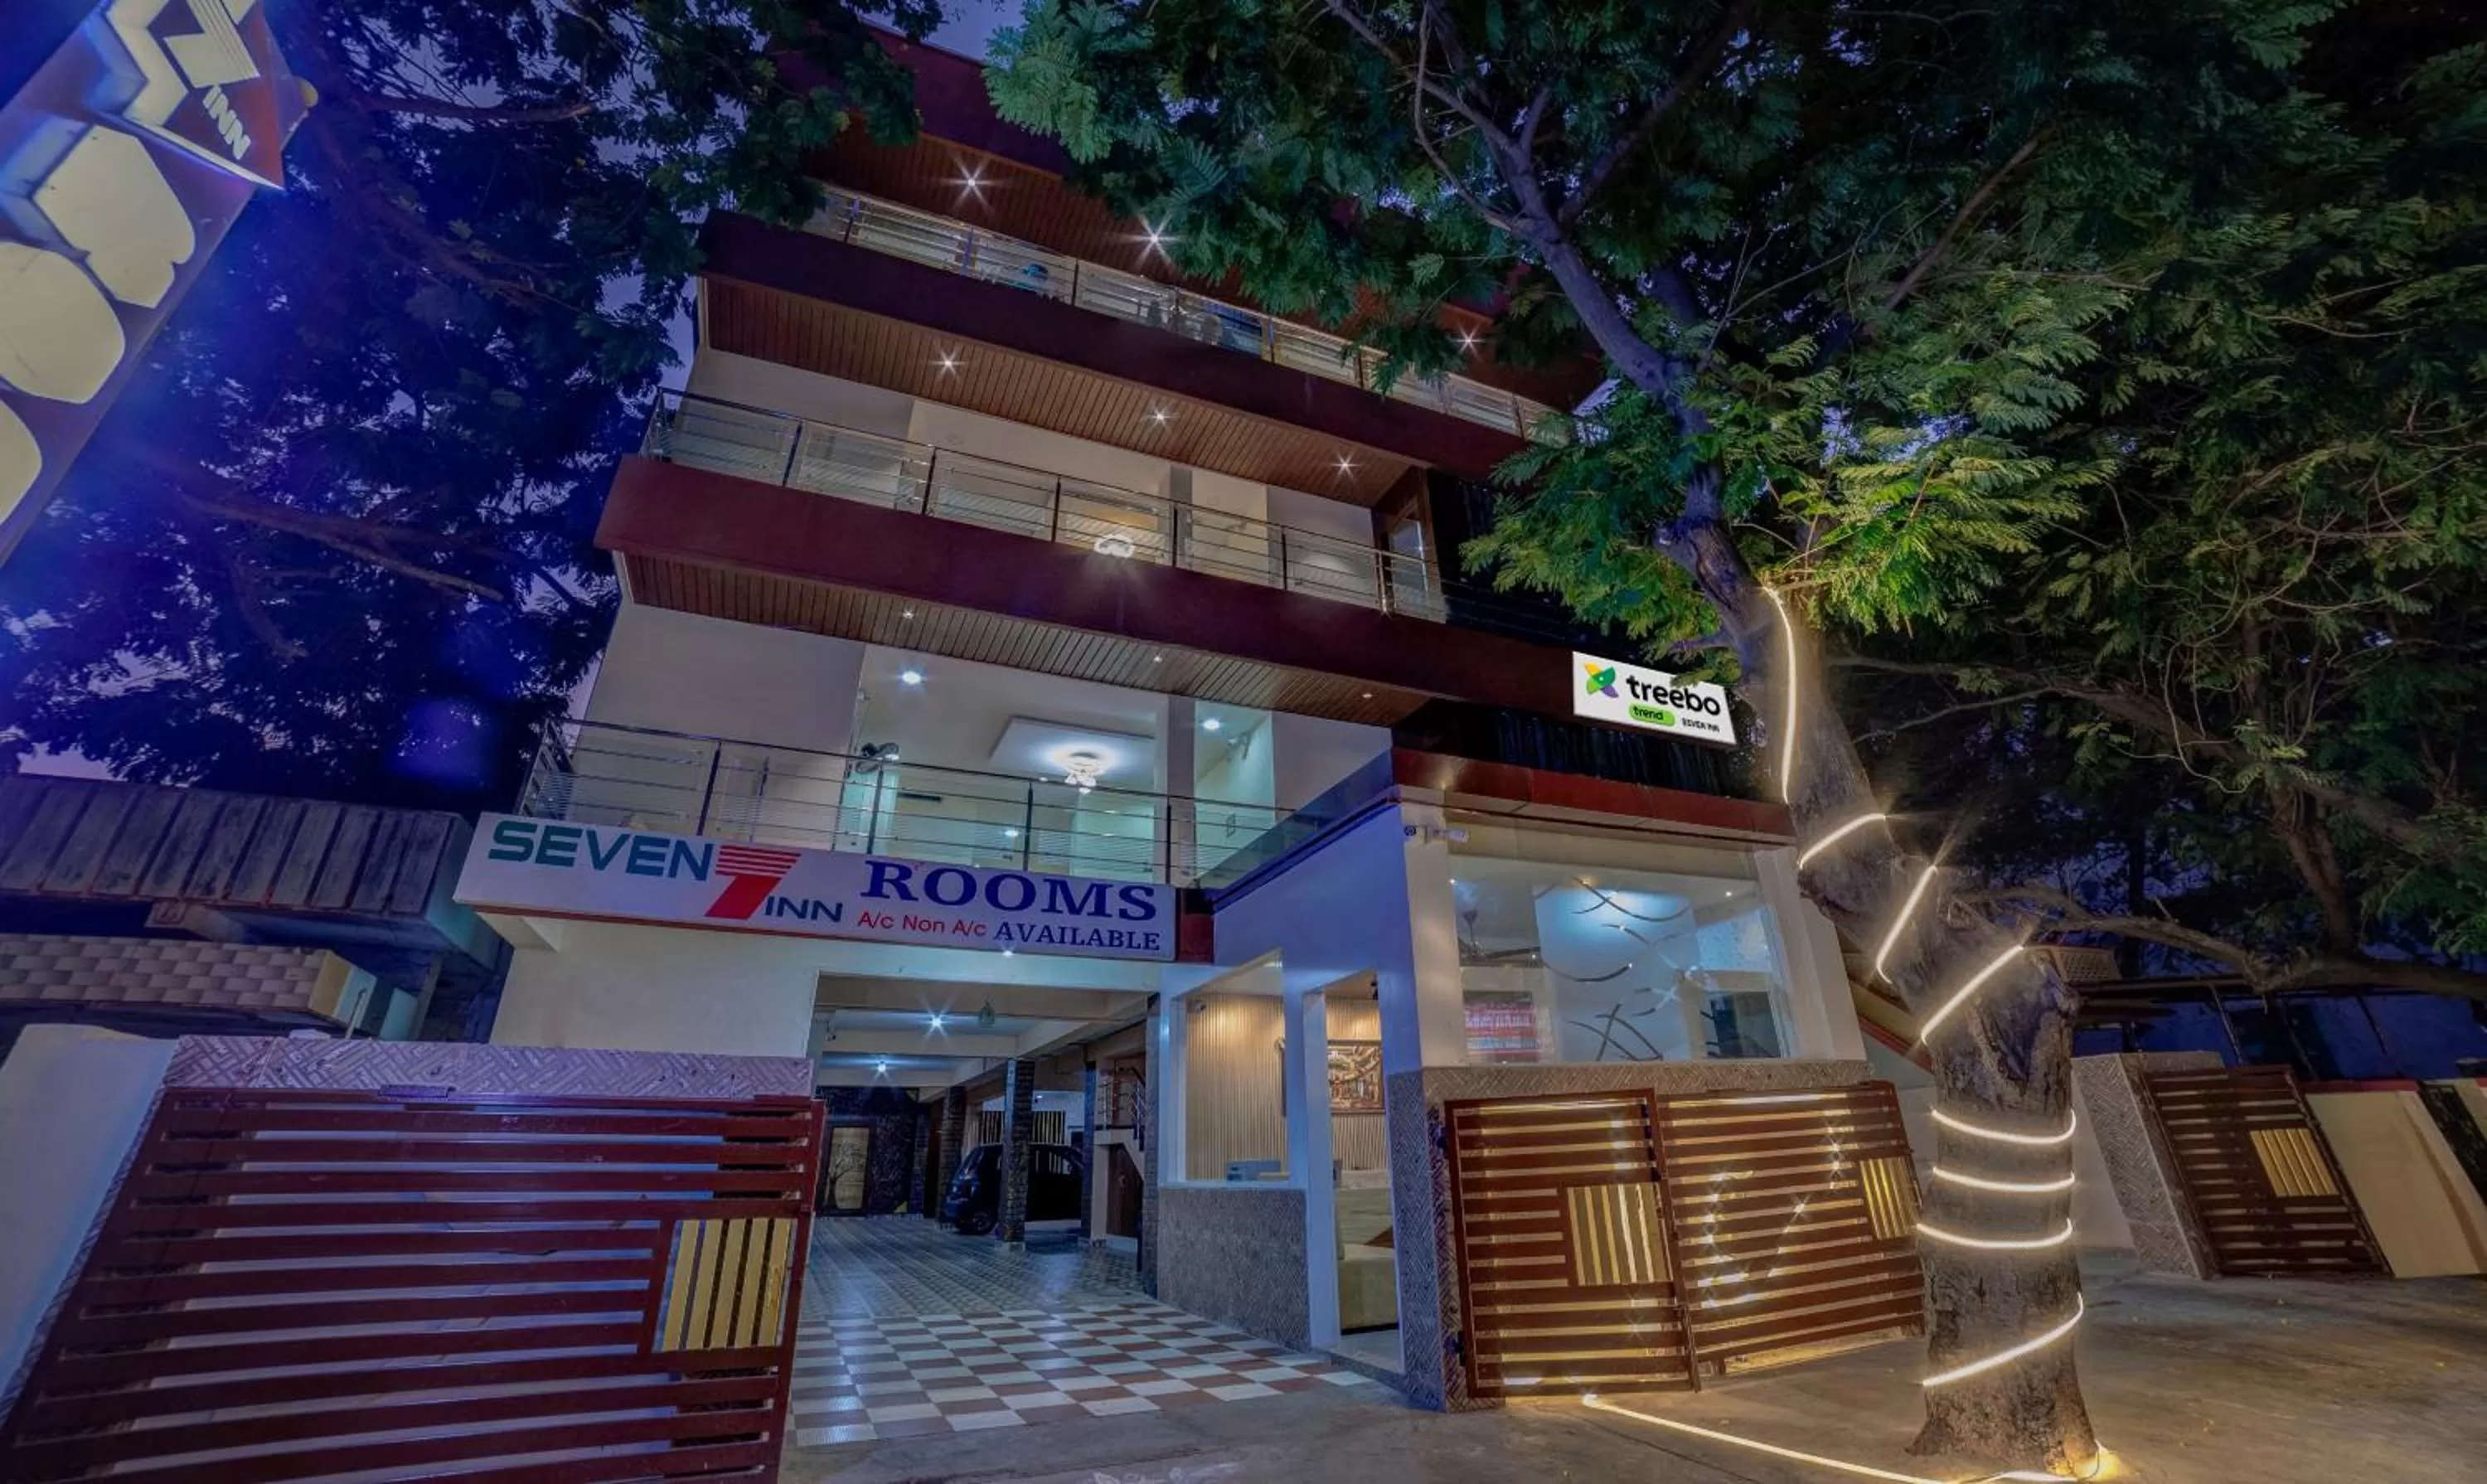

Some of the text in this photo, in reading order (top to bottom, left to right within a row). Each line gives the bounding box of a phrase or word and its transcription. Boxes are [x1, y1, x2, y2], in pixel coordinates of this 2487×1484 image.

[1626, 675, 1721, 715] treebo
[1633, 706, 1664, 720] trend
[488, 822, 843, 922] SEVEN 7 INN
[860, 860, 1156, 921] ROOMS
[858, 911, 1161, 951] A/c Non A/c AVAILABLE
